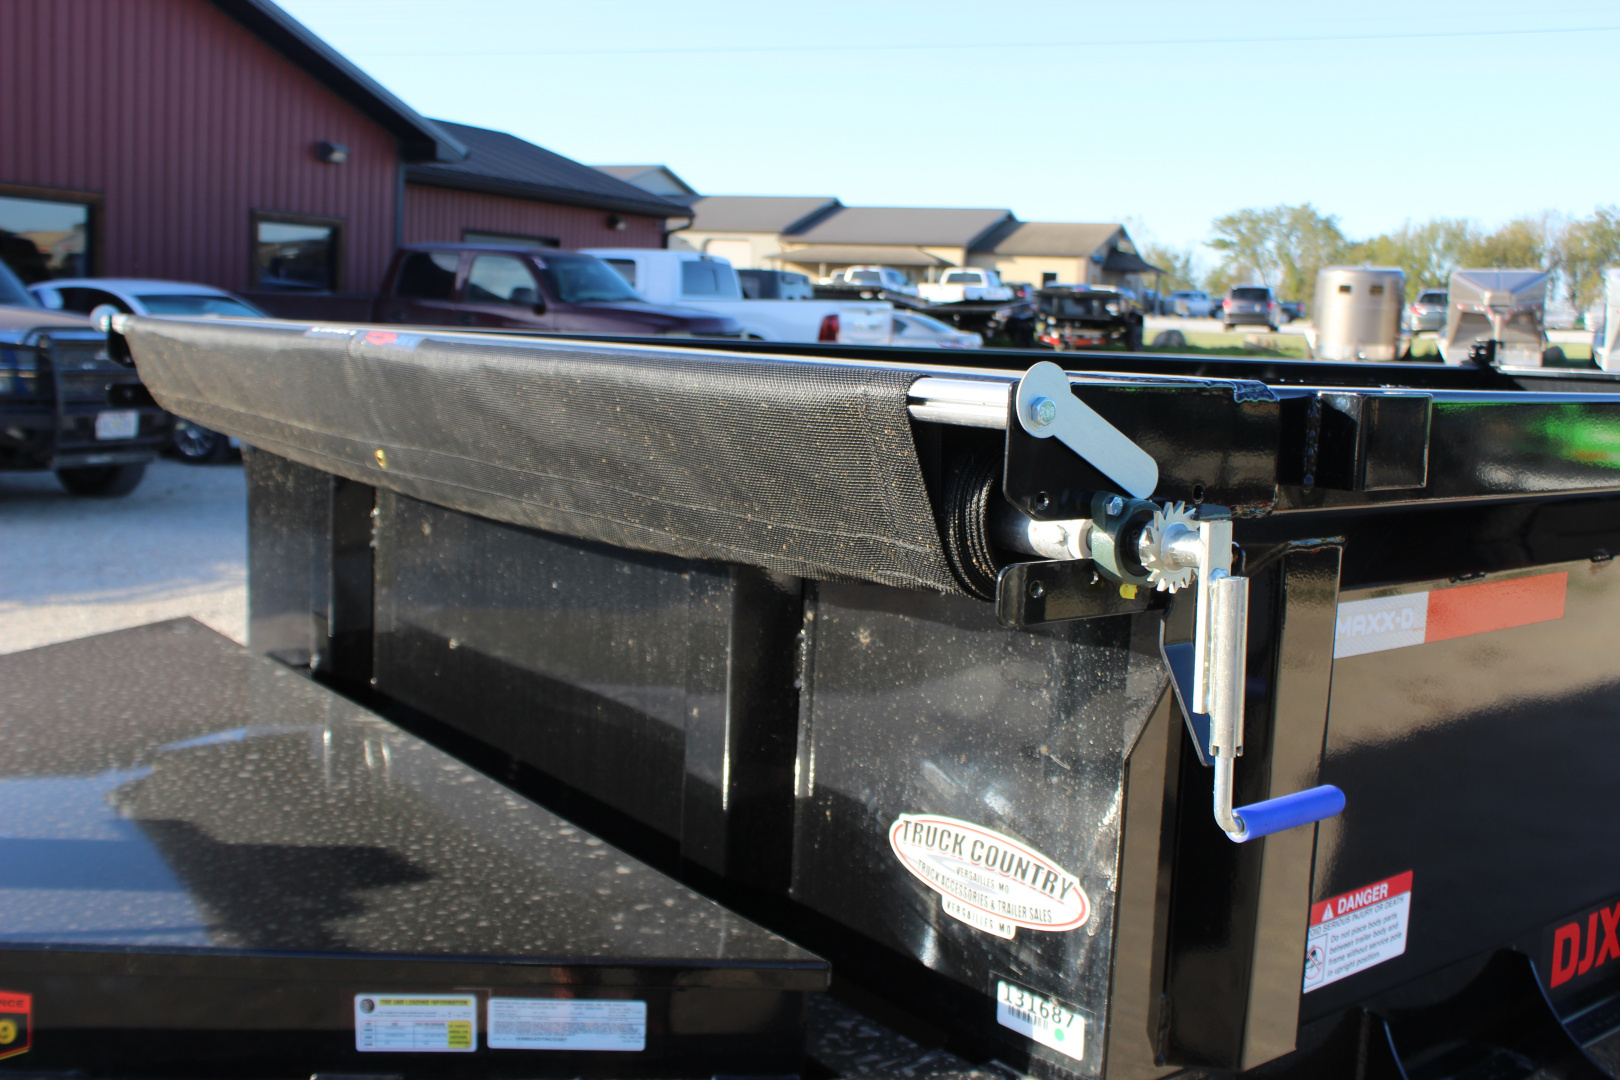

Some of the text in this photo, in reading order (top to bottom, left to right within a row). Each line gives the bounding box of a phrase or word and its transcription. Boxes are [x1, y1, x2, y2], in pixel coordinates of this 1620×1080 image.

[903, 820, 1074, 900] TRUCK COUNTRY
[918, 859, 1052, 923] TRUCK ACCESSORIES & TRAILER SALES
[956, 866, 1009, 894] VERSAILLES MO
[1337, 883, 1389, 914] DANGER
[946, 899, 1011, 935] VERSAILLES MO
[1310, 896, 1405, 937] OID SERIOUS INJURY OR DEATH
[1330, 913, 1398, 943] Do not place body parts
[1328, 955, 1345, 965] frame
[1346, 945, 1368, 958] without
[1368, 937, 1389, 950] service
[1329, 922, 1399, 954] between trailer body and
[1550, 901, 1620, 989] DJX
[1333, 961, 1355, 975] upright
[0, 999, 24, 1009] NCE
[1004, 985, 1075, 1028] 131687
